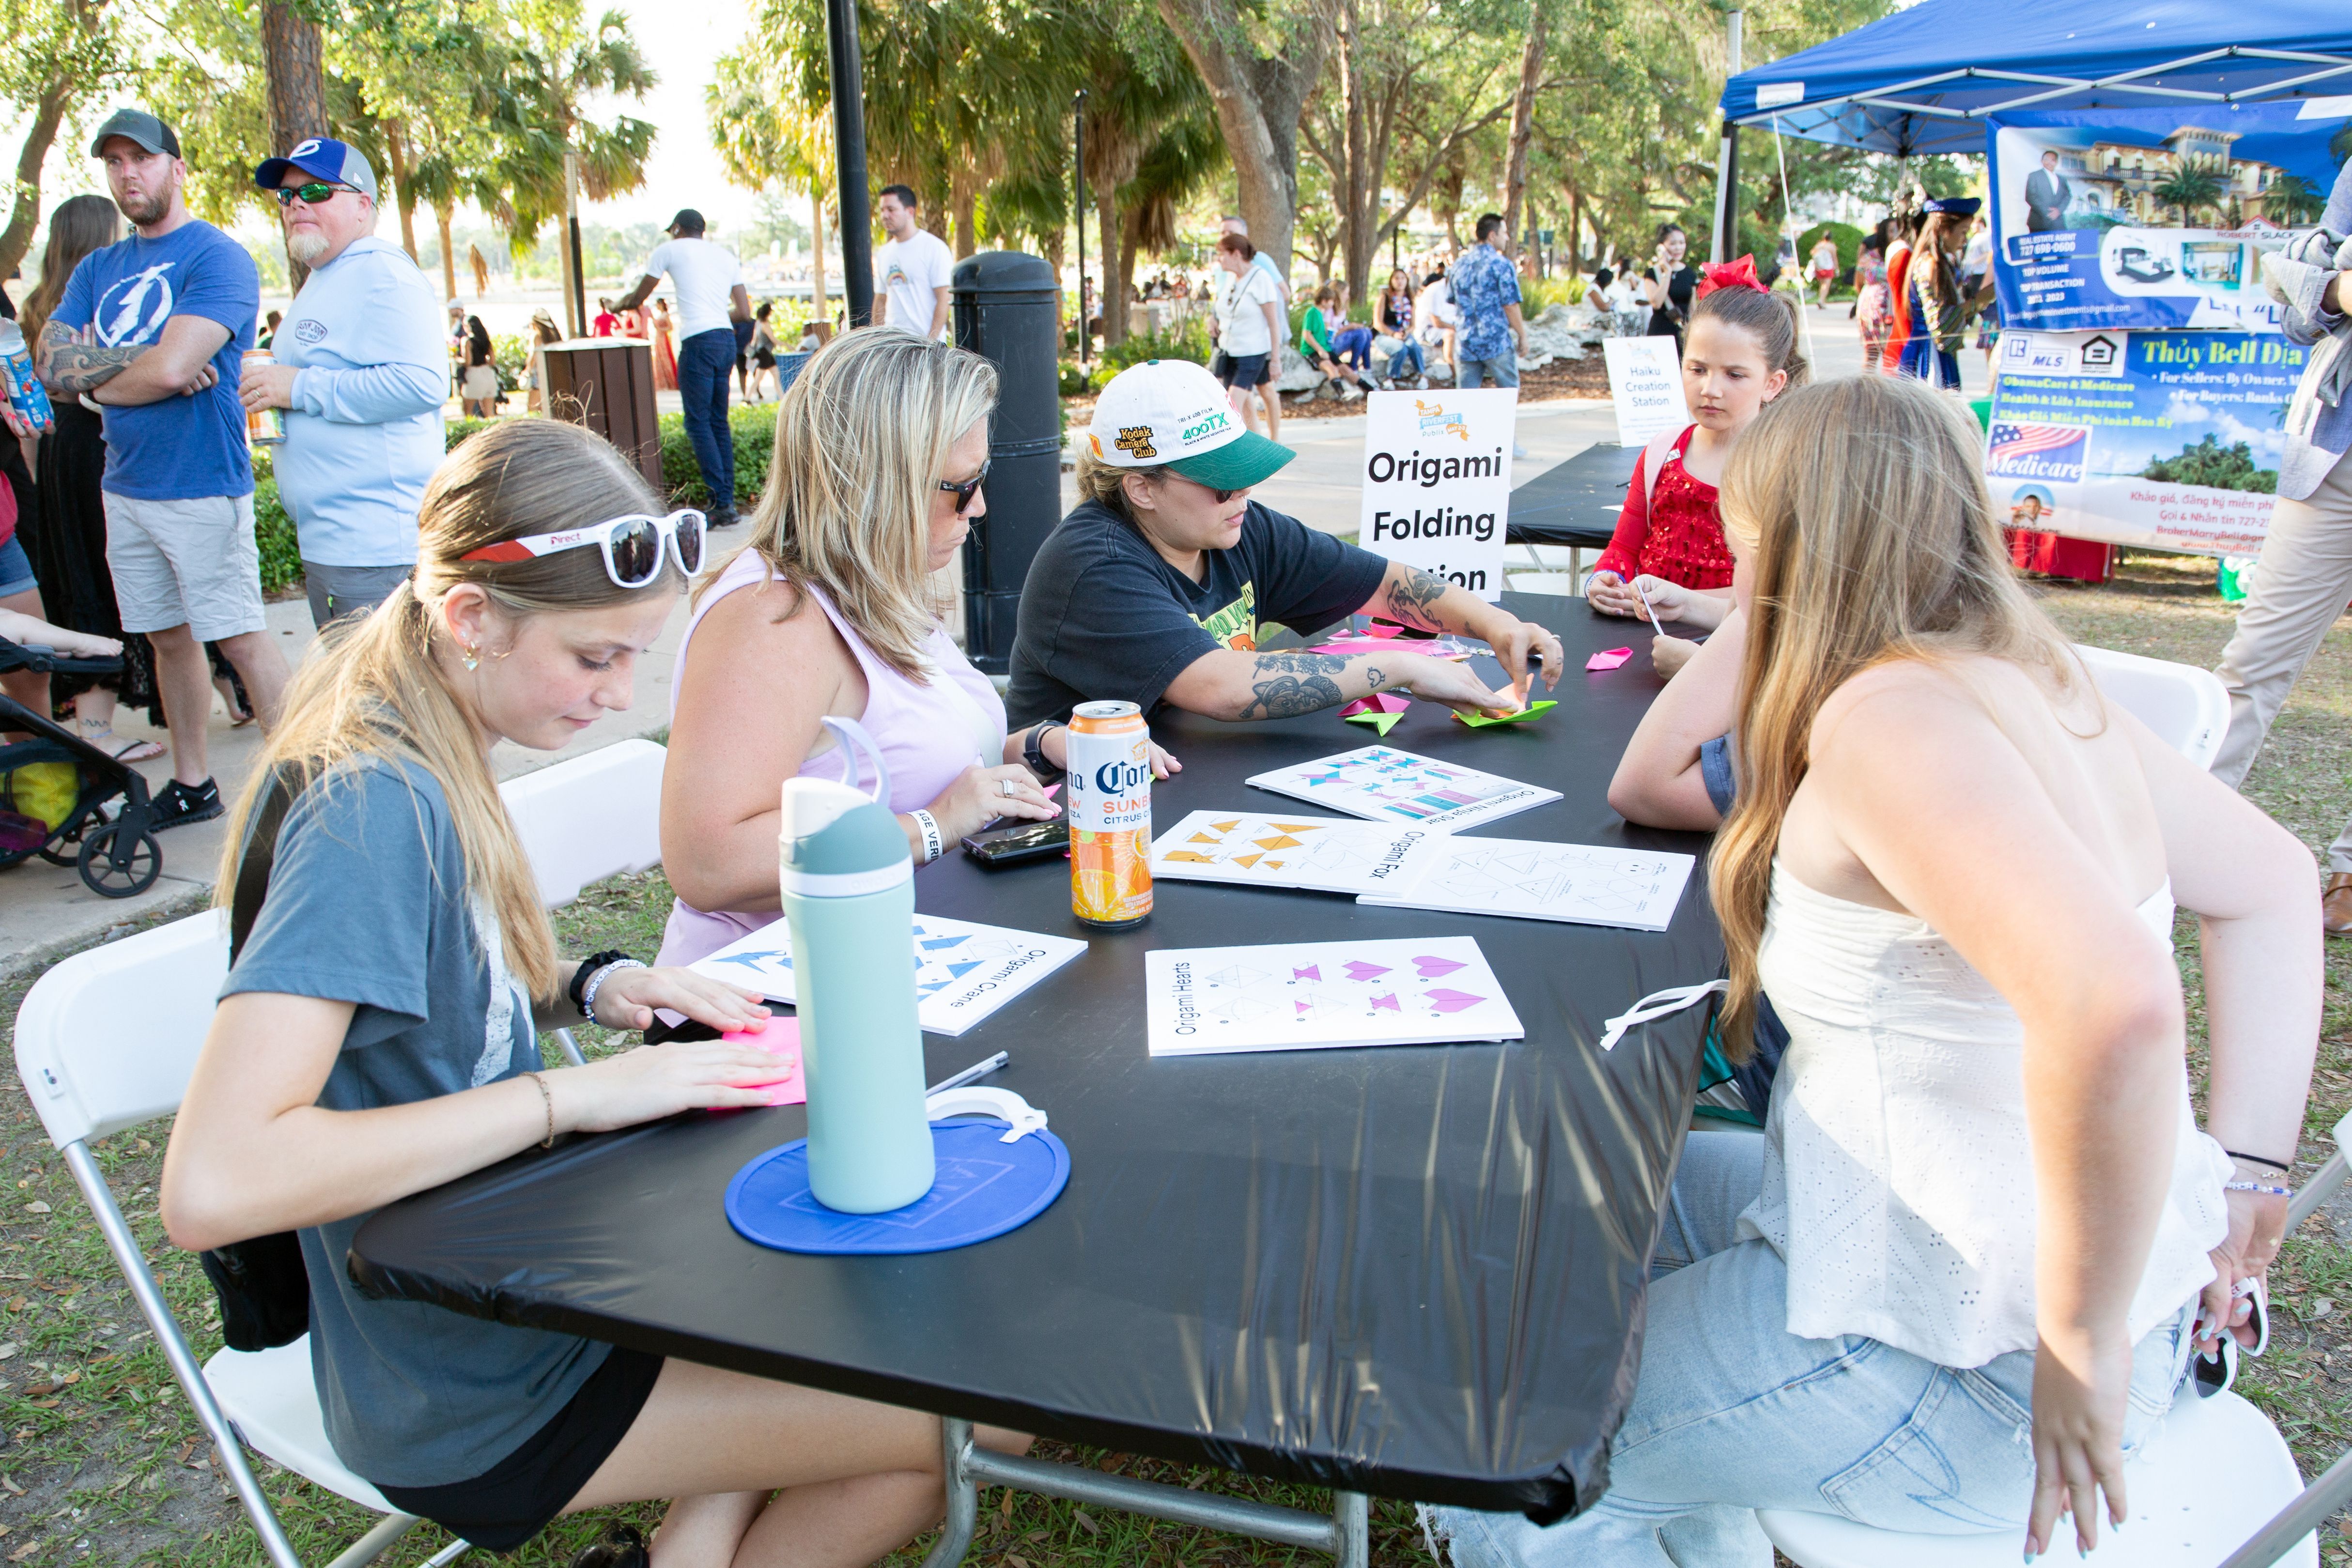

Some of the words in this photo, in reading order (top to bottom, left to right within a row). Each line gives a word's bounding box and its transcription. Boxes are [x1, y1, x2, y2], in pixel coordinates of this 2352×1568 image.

[2034, 234, 2054, 244] ESTATE
[2055, 233, 2076, 241] AGENT
[2020, 245, 2034, 256] 727
[2034, 242, 2075, 254] 698-0600
[2023, 267, 2035, 277] TOP
[2036, 264, 2069, 276] VOLUME
[2032, 278, 2085, 292] TRANSACTION
[2045, 292, 2065, 303] 2023
[2033, 356, 2063, 367] MLS
[2142, 338, 2204, 370] Thủy
[2209, 341, 2257, 364] Bell
[2261, 342, 2303, 370] Địa
[1630, 367, 1661, 377] Haiku
[2160, 371, 2181, 384] For
[2226, 372, 2240, 387] By
[1625, 382, 1671, 392] Creation
[2003, 377, 2068, 389] ObamaCare
[2081, 380, 2135, 391] Medicare
[1632, 397, 1670, 406] Station
[2001, 393, 2039, 404] Health
[2051, 396, 2073, 406] Life
[2075, 397, 2134, 409] Insurance
[2178, 389, 2199, 401] For
[2245, 392, 2283, 404] Banks
[1177, 415, 1191, 424] TRI-X
[1201, 407, 1213, 415] FILM
[1421, 407, 1440, 415] TAMPA
[1182, 412, 1229, 440] 400TX
[1422, 416, 1458, 426] RIVERFEST
[1120, 426, 1152, 441] Kodak
[1423, 429, 1443, 437] Publix
[1115, 437, 1148, 449] Camera
[1133, 446, 1156, 458] Club
[1368, 446, 1502, 488] Origami
[1987, 453, 2083, 478] Medicare
[1373, 507, 1495, 542] Folding
[2222, 515, 2235, 525] tin
[1492, 790, 1534, 807] Origami
[1452, 801, 1490, 817] Ninja
[917, 813, 933, 828] AGE
[1104, 813, 1142, 824] CITRUS
[1425, 815, 1455, 825] Star
[1383, 831, 1425, 862] Origami
[1369, 863, 1400, 879] Fox
[990, 950, 1046, 982] Origami
[1172, 962, 1193, 992] Hearts
[950, 982, 997, 1007] Crane
[1172, 994, 1201, 1035] Origami
